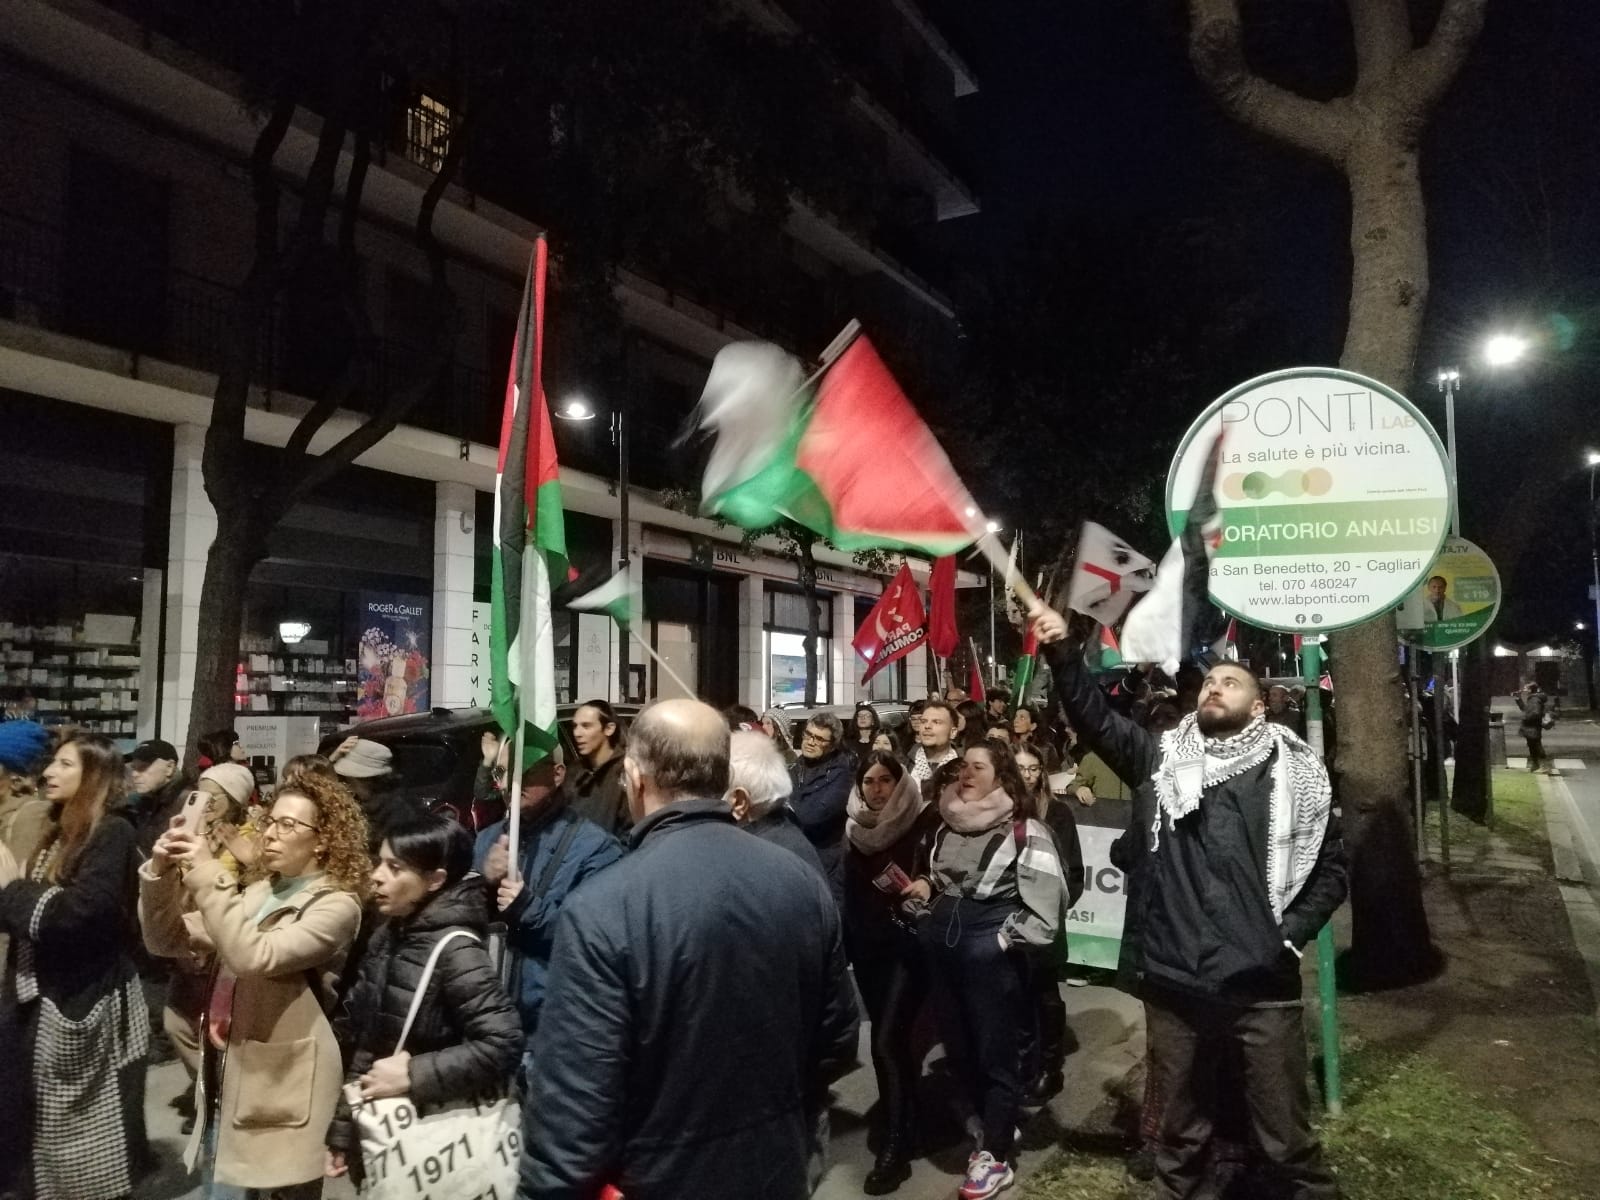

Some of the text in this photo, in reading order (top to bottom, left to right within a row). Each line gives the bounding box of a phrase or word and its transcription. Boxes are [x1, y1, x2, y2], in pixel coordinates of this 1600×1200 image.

[1221, 391, 1373, 437] PONTI
[1222, 441, 1411, 464] La salute è più vicina.
[1224, 517, 1438, 542] ORATORIO ANALISI
[716, 551, 741, 564] BNL
[1223, 564, 1248, 576] San
[1253, 562, 1328, 575] Benedetto,
[1333, 561, 1351, 572] 20
[1367, 558, 1421, 574] Cagliari
[1260, 577, 1358, 591] tel. 070 480247
[368, 603, 394, 613] ROGER
[398, 605, 423, 616] GALLET
[1249, 593, 1370, 607] www.labponti.com
[470, 610, 480, 708] FARMA
[408, 1133, 472, 1192] 1971
